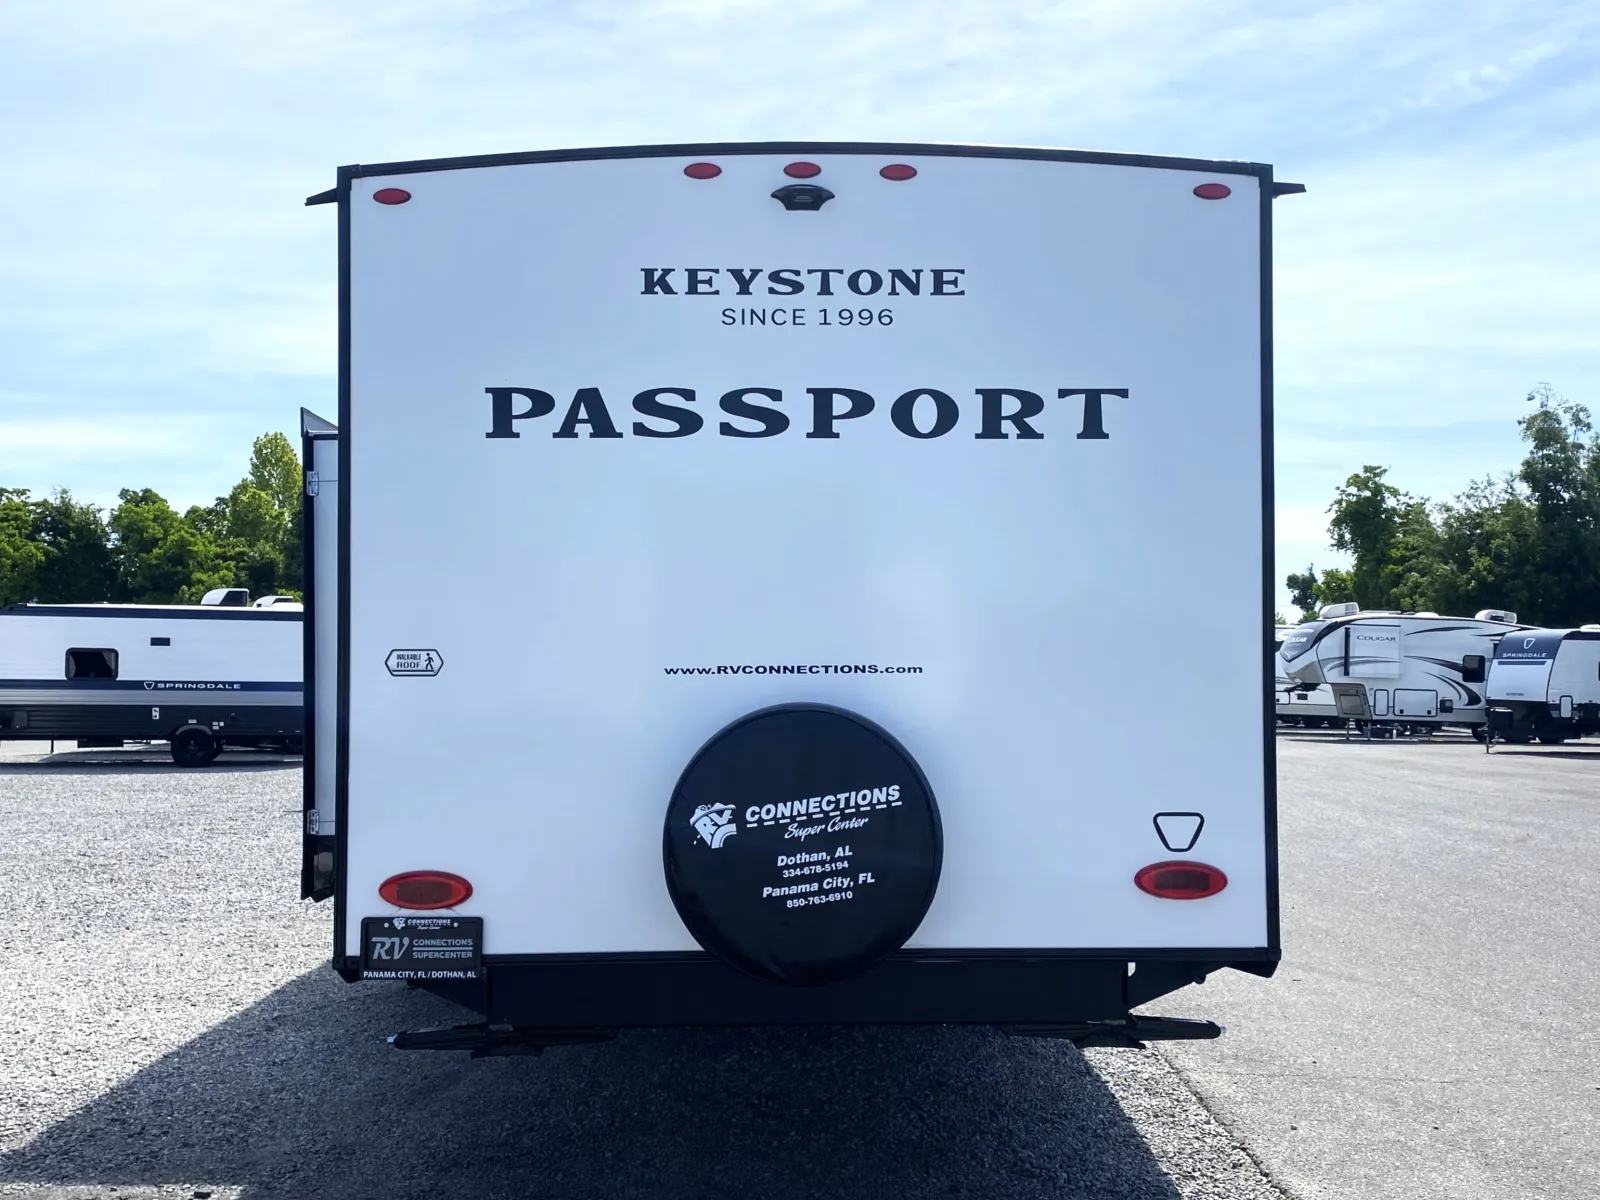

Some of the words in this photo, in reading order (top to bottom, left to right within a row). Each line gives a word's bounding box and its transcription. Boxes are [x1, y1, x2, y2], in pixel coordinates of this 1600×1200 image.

[640, 268, 966, 296] KEYSTONE
[721, 308, 806, 326] SINCE
[818, 308, 894, 326] 1996
[484, 387, 1130, 439] PASSPORT
[396, 661, 421, 669] ROOF
[664, 664, 923, 675] www.RVCONNECTIONS.com
[745, 785, 901, 822] CONNECTIONS
[784, 822, 825, 842] Super
[827, 816, 869, 833] Center
[777, 850, 831, 867] Dothan,
[834, 845, 853, 857] AL
[782, 860, 849, 878] 334-678-5194
[762, 882, 819, 898] Panama
[822, 876, 854, 889] City,
[858, 872, 876, 884] FL
[786, 890, 853, 908] 850-763-6910
[371, 937, 410, 960] RV
[412, 938, 473, 946] CONNECTIONS
[412, 951, 473, 959] SUPERCENTER
[363, 970, 396, 978] PANAMA
[397, 970, 417, 979] CITY,
[418, 970, 427, 978] FL
[431, 970, 466, 979] DOTHAN,
[467, 970, 476, 978] AL
